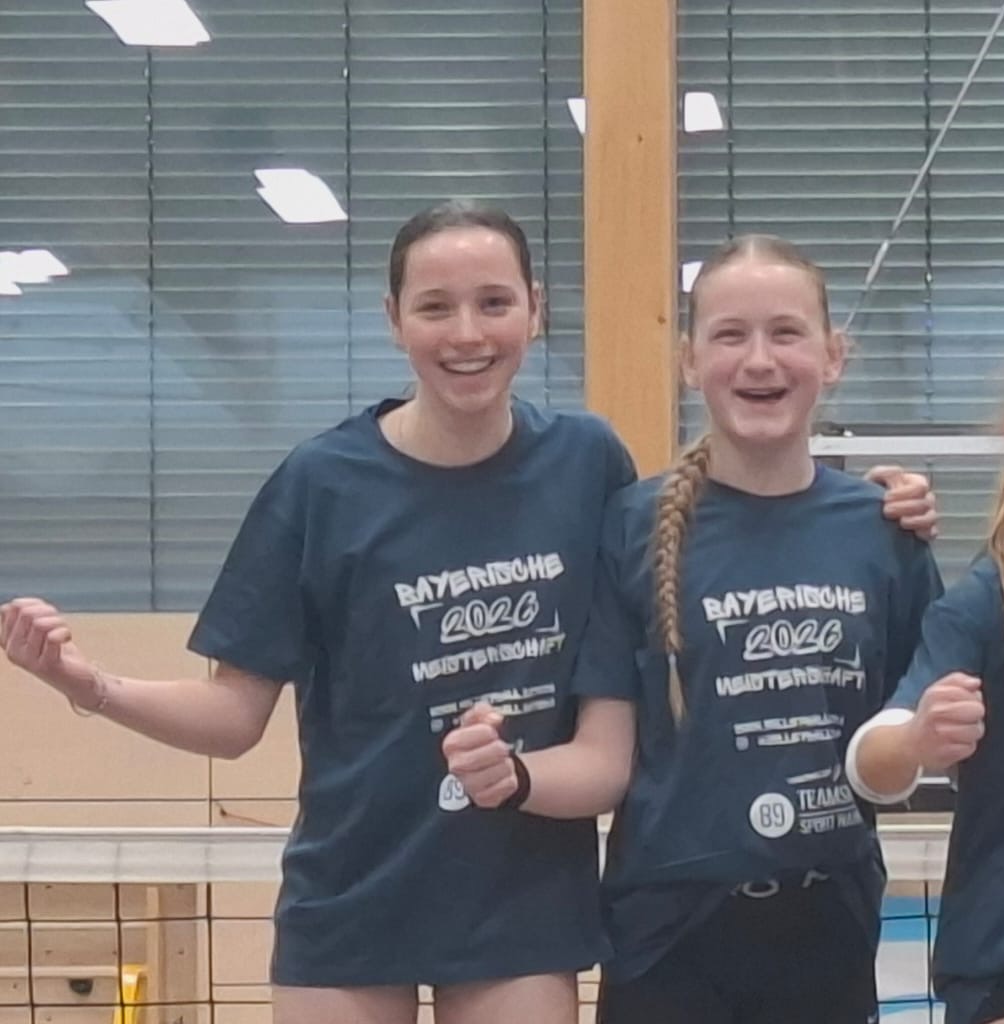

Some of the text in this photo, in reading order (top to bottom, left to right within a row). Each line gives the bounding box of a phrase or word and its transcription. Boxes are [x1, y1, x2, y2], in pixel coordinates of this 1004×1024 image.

[394, 552, 565, 607] BAYERISCHE
[440, 590, 540, 643] 2026
[702, 584, 867, 621] BAYERISCHE
[743, 619, 843, 661] 2026
[759, 803, 785, 829] 89
[796, 784, 855, 811] TEAMS
